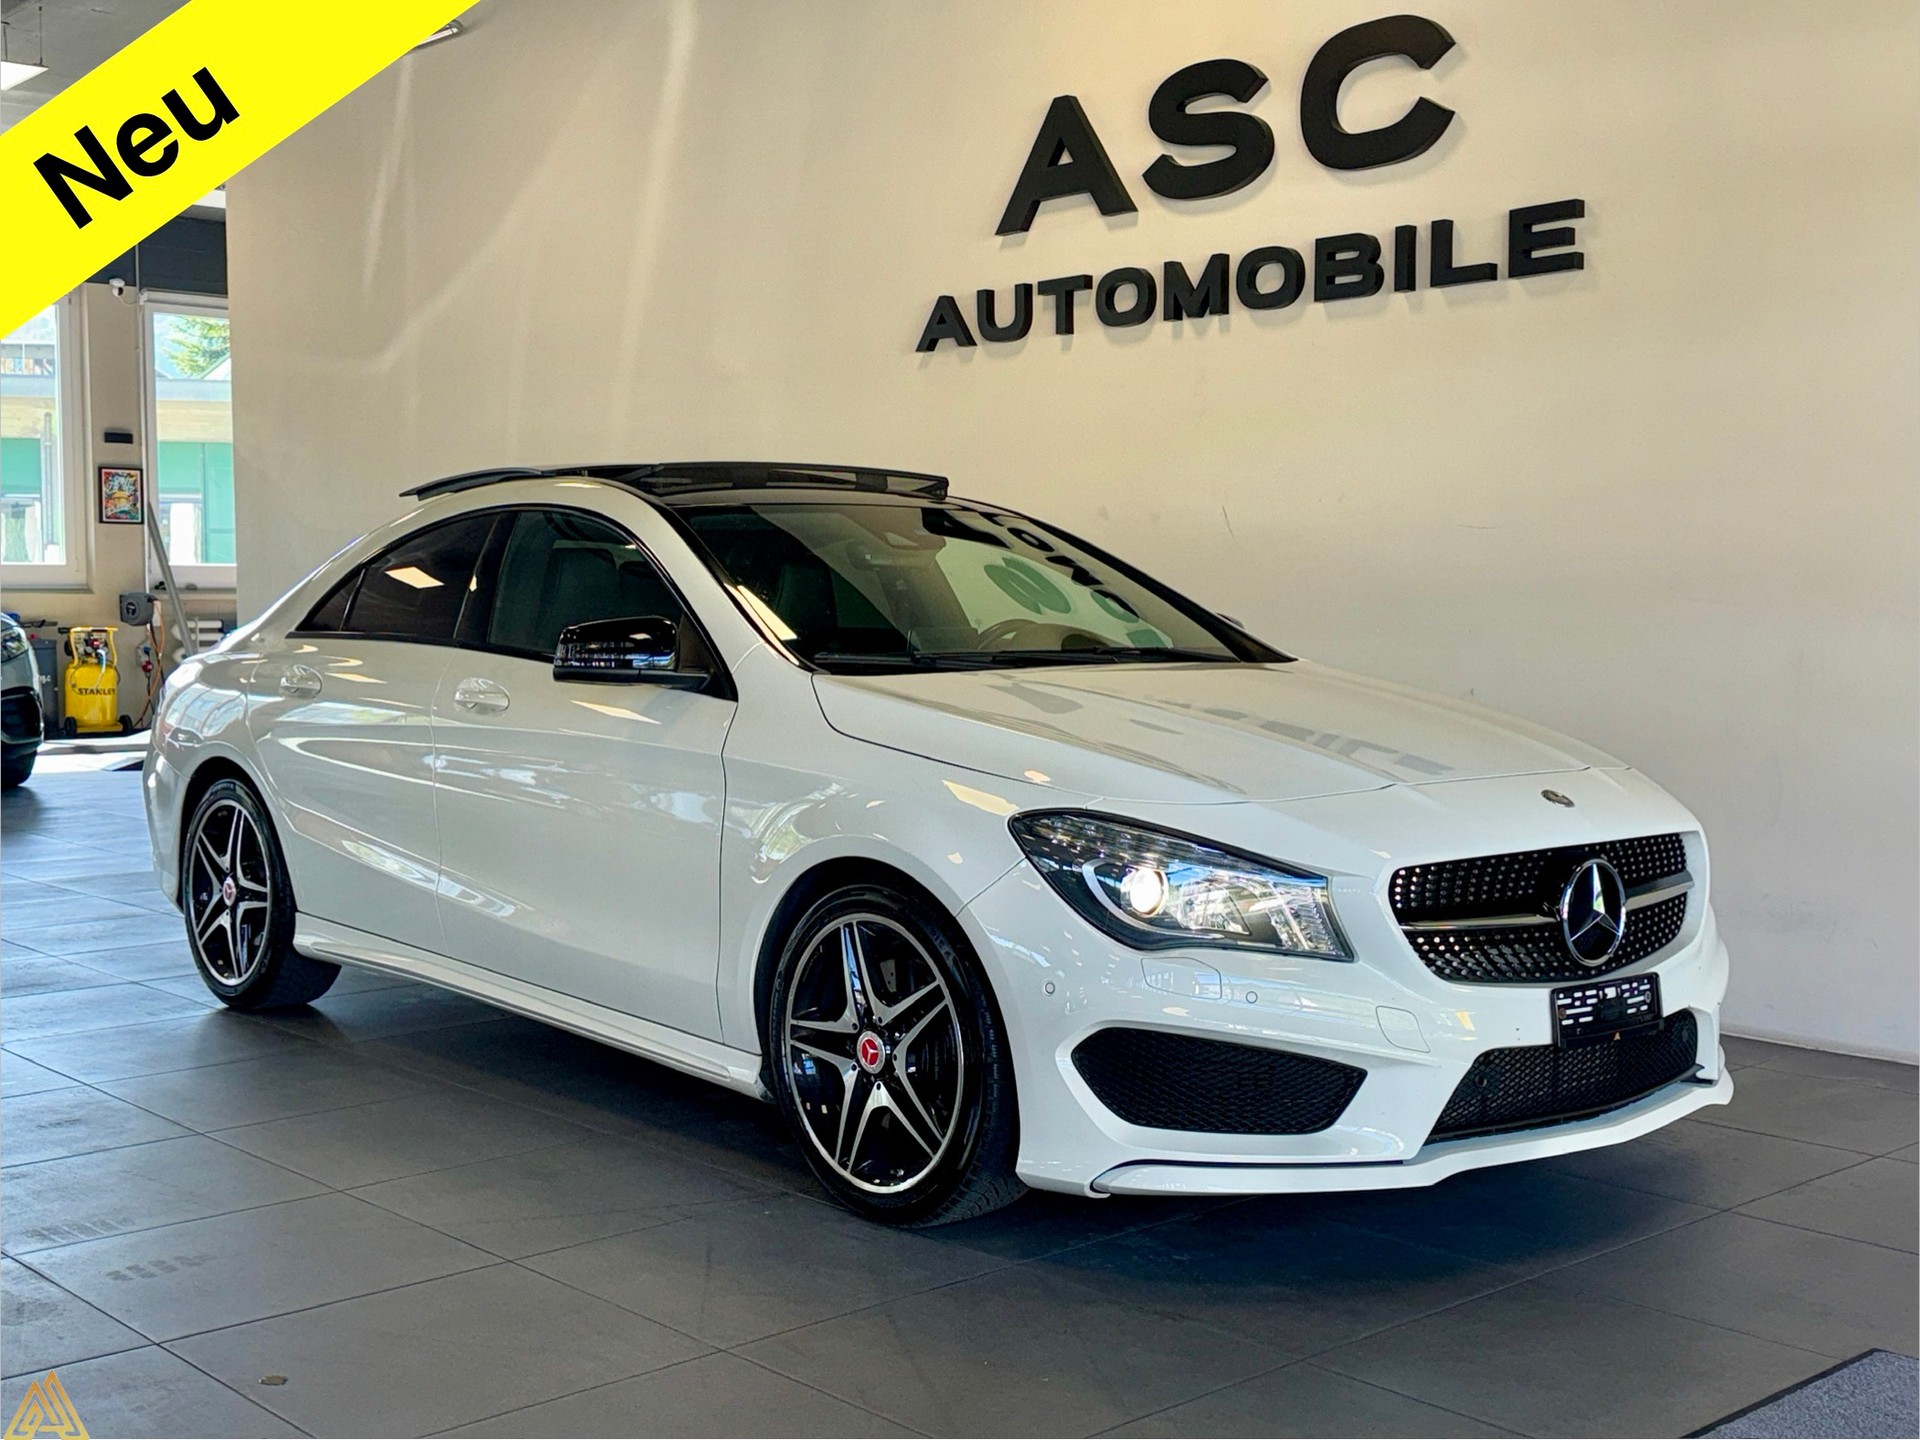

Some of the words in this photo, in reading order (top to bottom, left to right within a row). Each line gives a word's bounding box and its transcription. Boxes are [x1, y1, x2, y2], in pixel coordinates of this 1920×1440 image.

[995, 15, 1457, 236] ASC
[915, 199, 1585, 353] AUTOMOBILE
[78, 688, 116, 696] STANLEY
